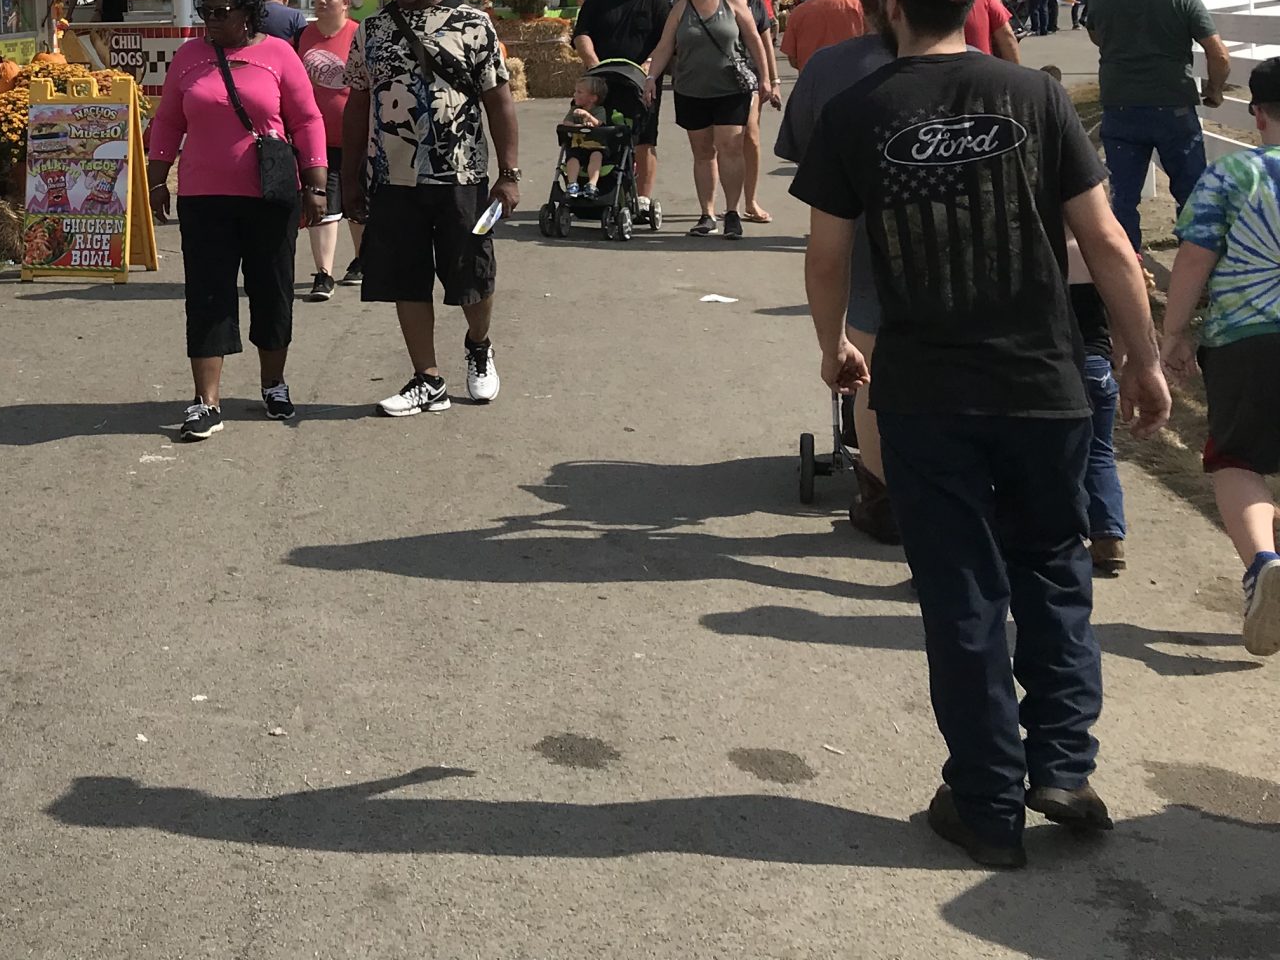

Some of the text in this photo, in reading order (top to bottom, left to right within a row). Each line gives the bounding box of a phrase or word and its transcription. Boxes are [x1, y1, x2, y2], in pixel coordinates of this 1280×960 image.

[111, 34, 141, 49] CHILI
[110, 51, 144, 67] DOGS
[73, 105, 119, 121] NACHOS
[68, 121, 122, 140] MUCHO
[910, 120, 1000, 160] Ford
[62, 218, 124, 234] CHICKEN
[75, 234, 111, 250] RICE
[70, 250, 112, 267] BOWL
